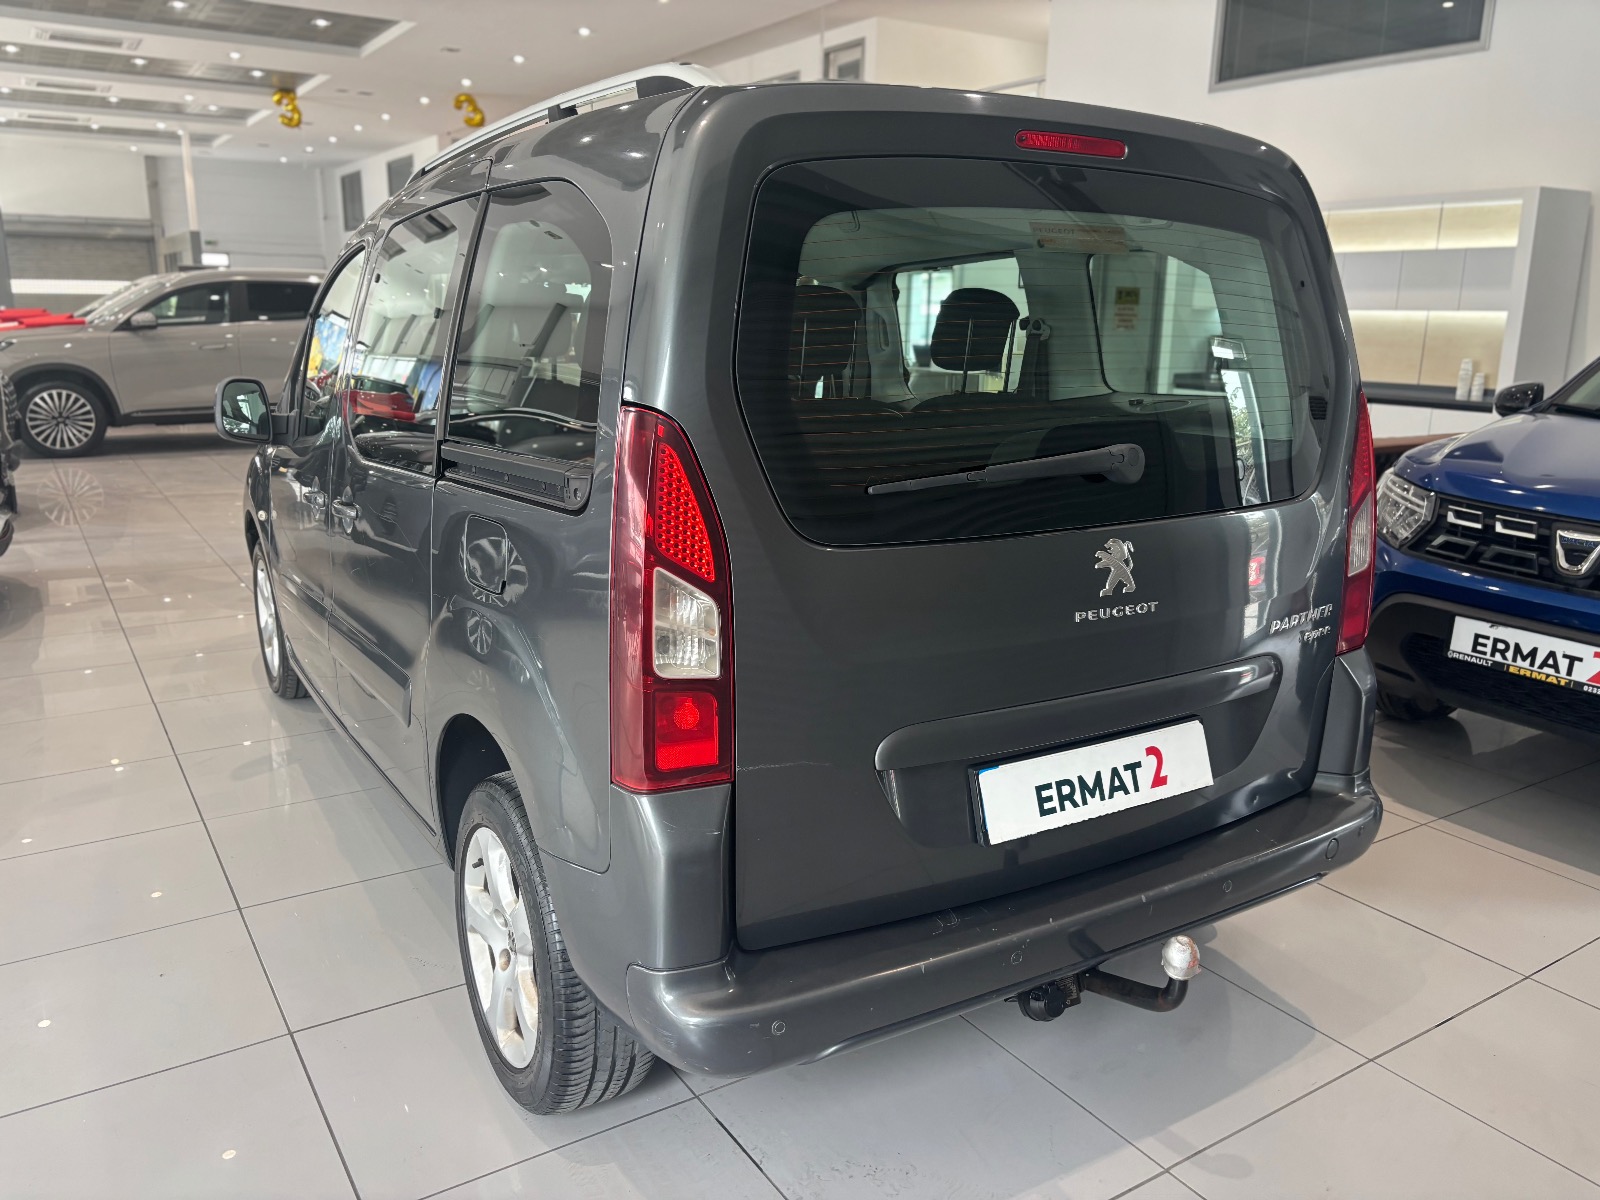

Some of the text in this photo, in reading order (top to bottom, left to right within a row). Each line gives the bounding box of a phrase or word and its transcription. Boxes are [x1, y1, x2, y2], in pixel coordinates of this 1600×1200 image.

[1075, 601, 1159, 623] PEUGEOT
[1269, 603, 1333, 635] PARTNER
[1452, 652, 1494, 667] RENAULT
[1509, 665, 1569, 686] ERMAT
[1471, 632, 1583, 678] ERMAT
[1035, 745, 1168, 818] ERMAT 2
